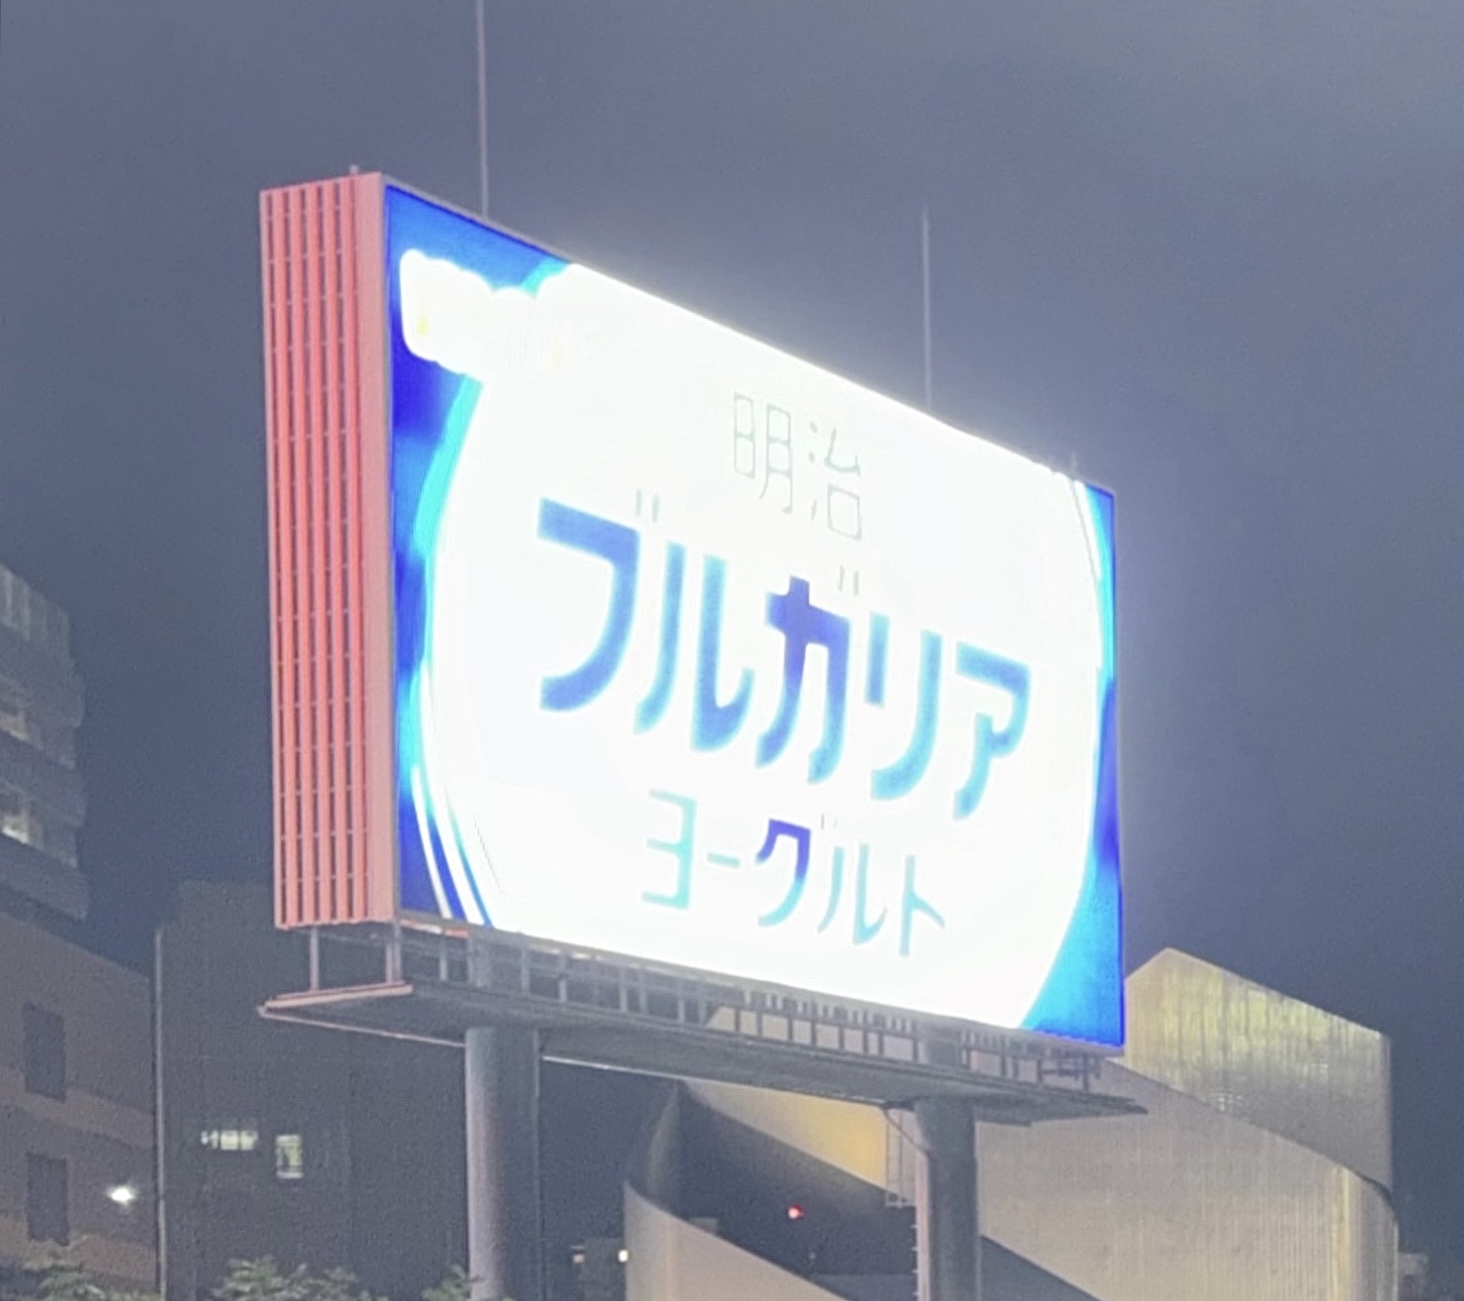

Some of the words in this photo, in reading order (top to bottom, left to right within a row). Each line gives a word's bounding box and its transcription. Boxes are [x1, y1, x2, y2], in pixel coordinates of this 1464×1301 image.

[732, 391, 864, 542] 明治
[536, 489, 1034, 822] ブルガリア
[641, 788, 947, 958] ヨーグルト
